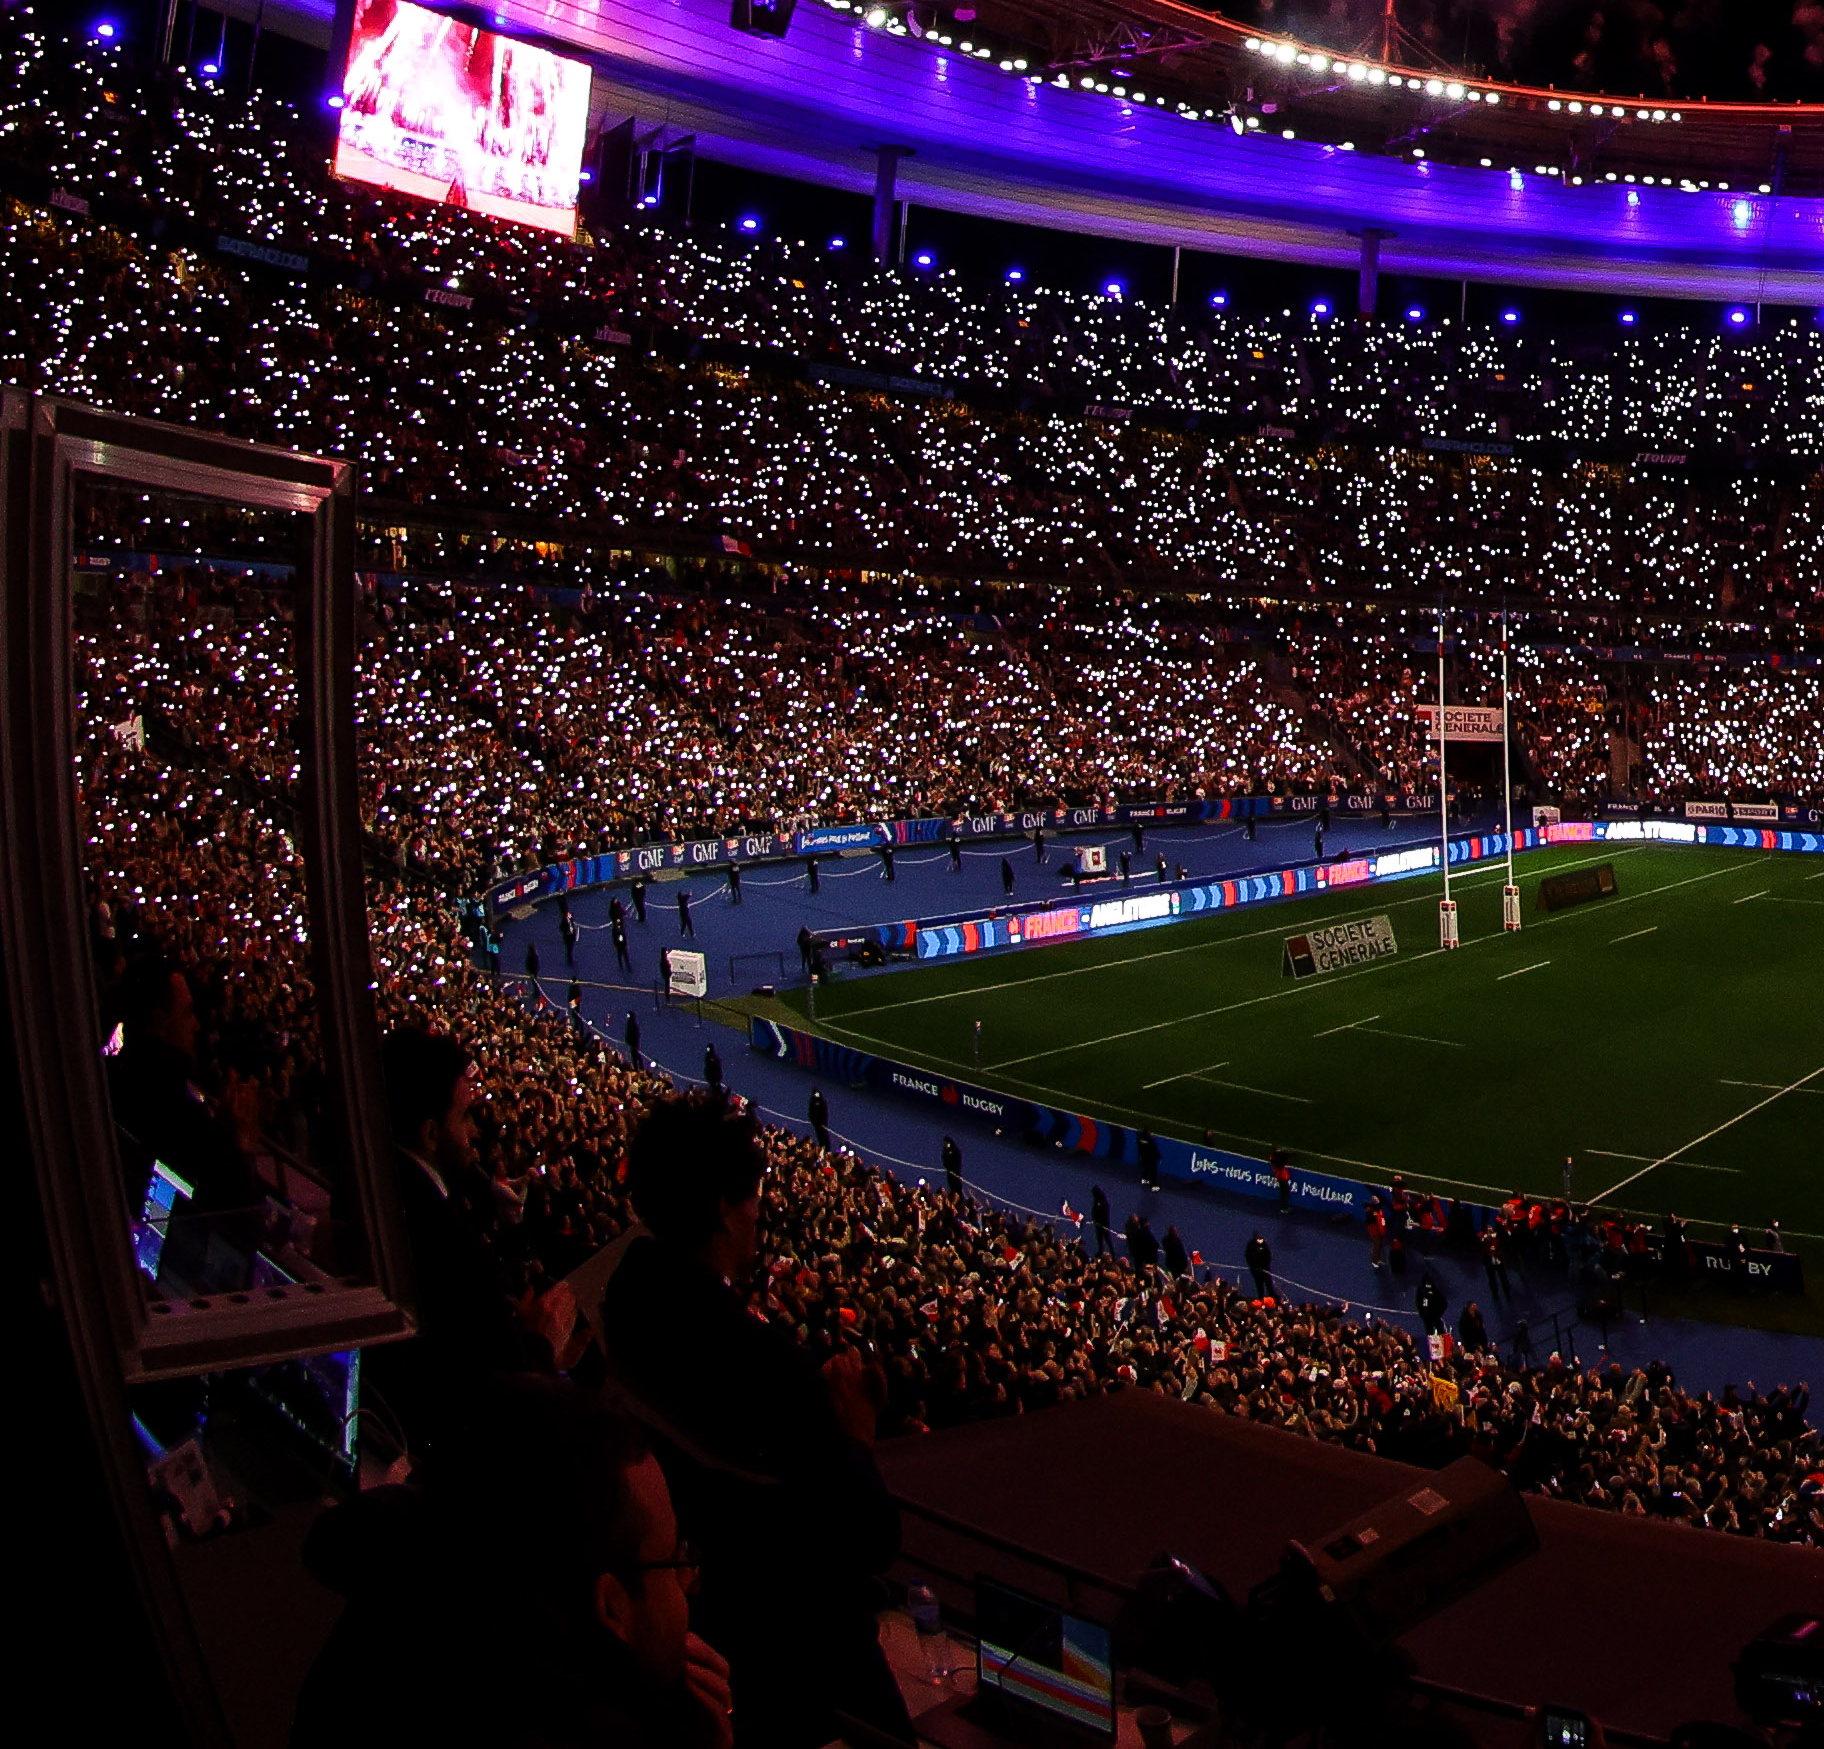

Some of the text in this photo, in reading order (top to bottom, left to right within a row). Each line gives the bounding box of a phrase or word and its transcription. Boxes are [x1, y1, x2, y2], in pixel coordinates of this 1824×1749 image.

[1292, 796, 1318, 810] GMF
[1348, 795, 1374, 810] GMF
[1406, 795, 1434, 810] GMF
[972, 816, 997, 833] GMF
[1023, 811, 1047, 828] GMF
[1073, 809, 1099, 825] GMF
[1547, 822, 1593, 842] FRANCE
[693, 842, 718, 865] GMF
[746, 837, 772, 857] GMF
[638, 851, 664, 871] GMF
[1328, 860, 1369, 885] FRANCE
[1023, 908, 1080, 940] FRANCE
[1313, 920, 1376, 951] SOCIETE
[1319, 936, 1395, 970] GENERALE
[892, 1072, 1004, 1116] FRANCE RUGBY
[1705, 1255, 1772, 1277] RUBY
